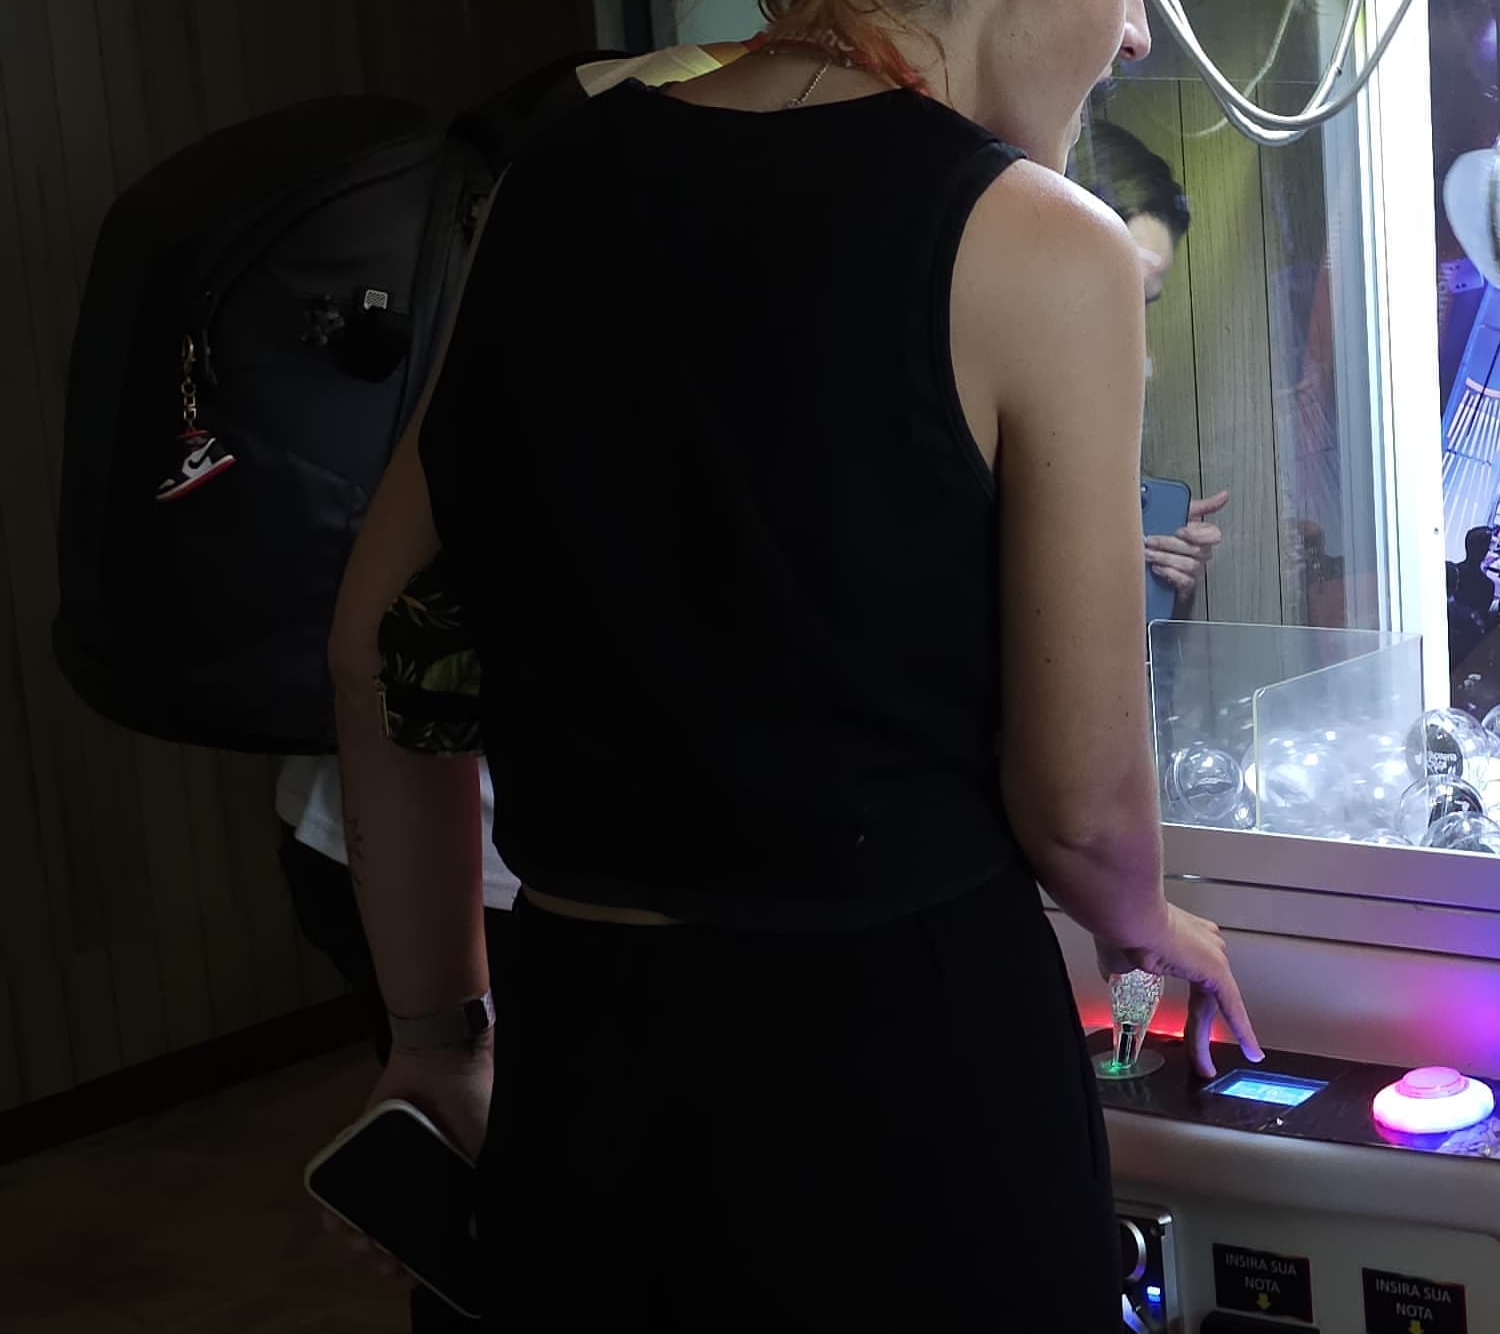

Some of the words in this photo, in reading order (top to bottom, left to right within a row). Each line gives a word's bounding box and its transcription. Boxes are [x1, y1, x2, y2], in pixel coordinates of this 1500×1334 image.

[1225, 1253, 1267, 1272] INSIRA
[1270, 1260, 1297, 1277] SUA
[1244, 1276, 1281, 1294] NOTA
[1375, 1278, 1420, 1299] INSIRA
[1423, 1287, 1452, 1304] SUA
[1396, 1302, 1434, 1321] NOTA
